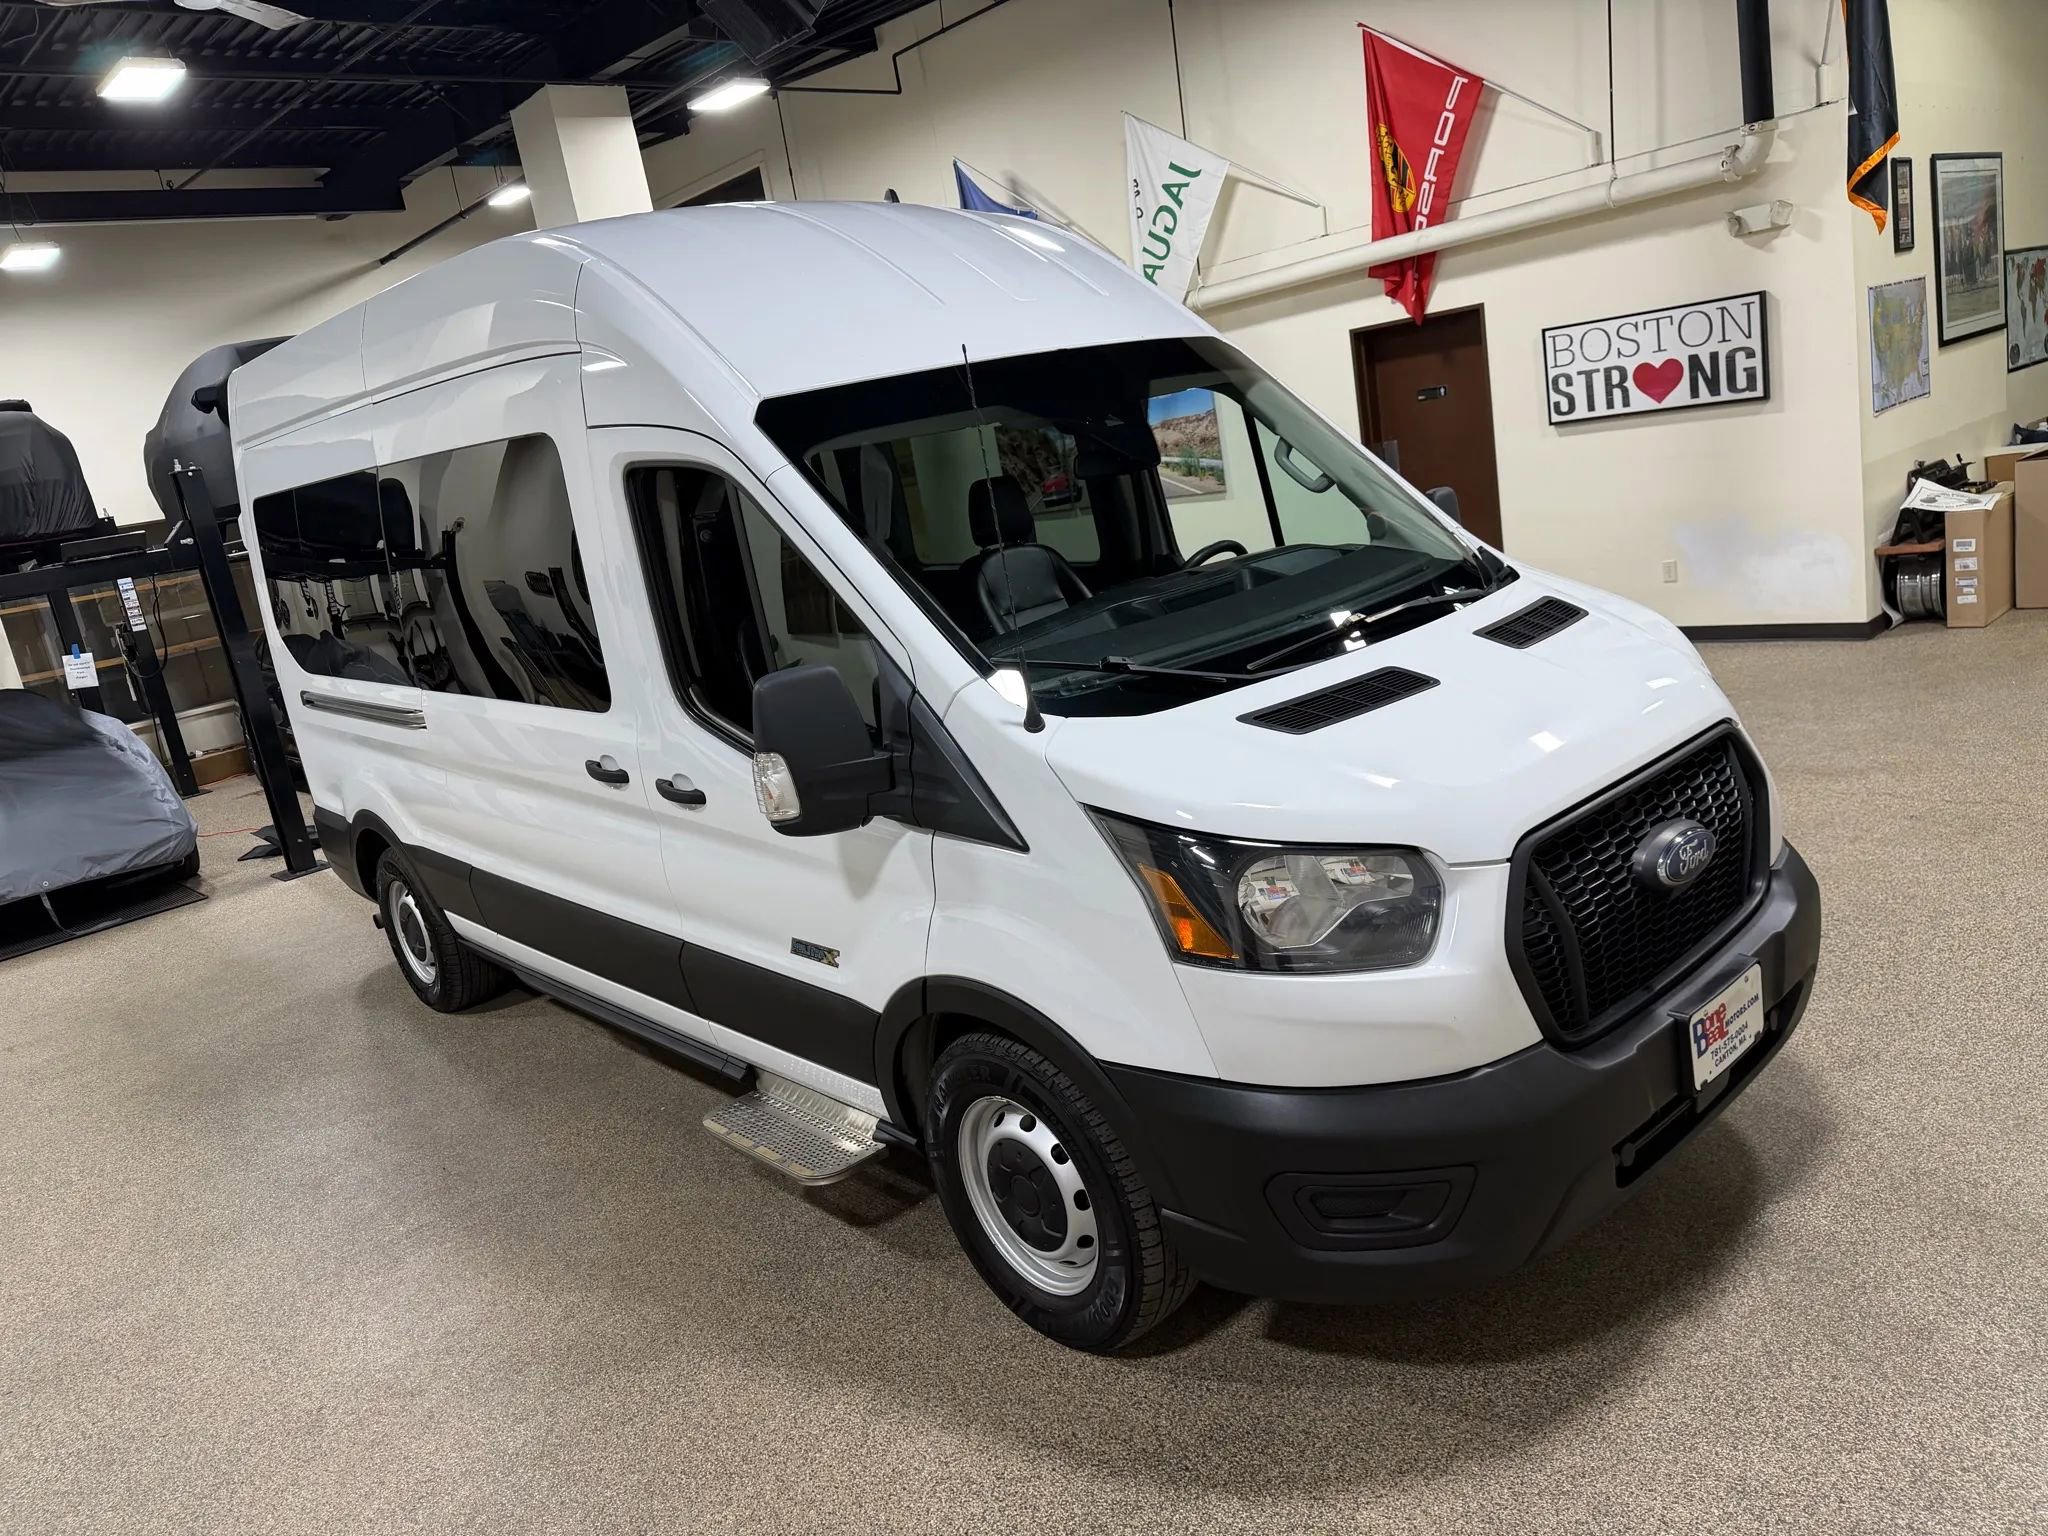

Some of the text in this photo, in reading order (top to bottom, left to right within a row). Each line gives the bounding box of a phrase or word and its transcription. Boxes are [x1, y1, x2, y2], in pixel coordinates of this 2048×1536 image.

[1548, 302, 1755, 368] BOSTON
[1679, 838, 1709, 875] Ford
[1725, 993, 1759, 1027] MOTORS.COM
